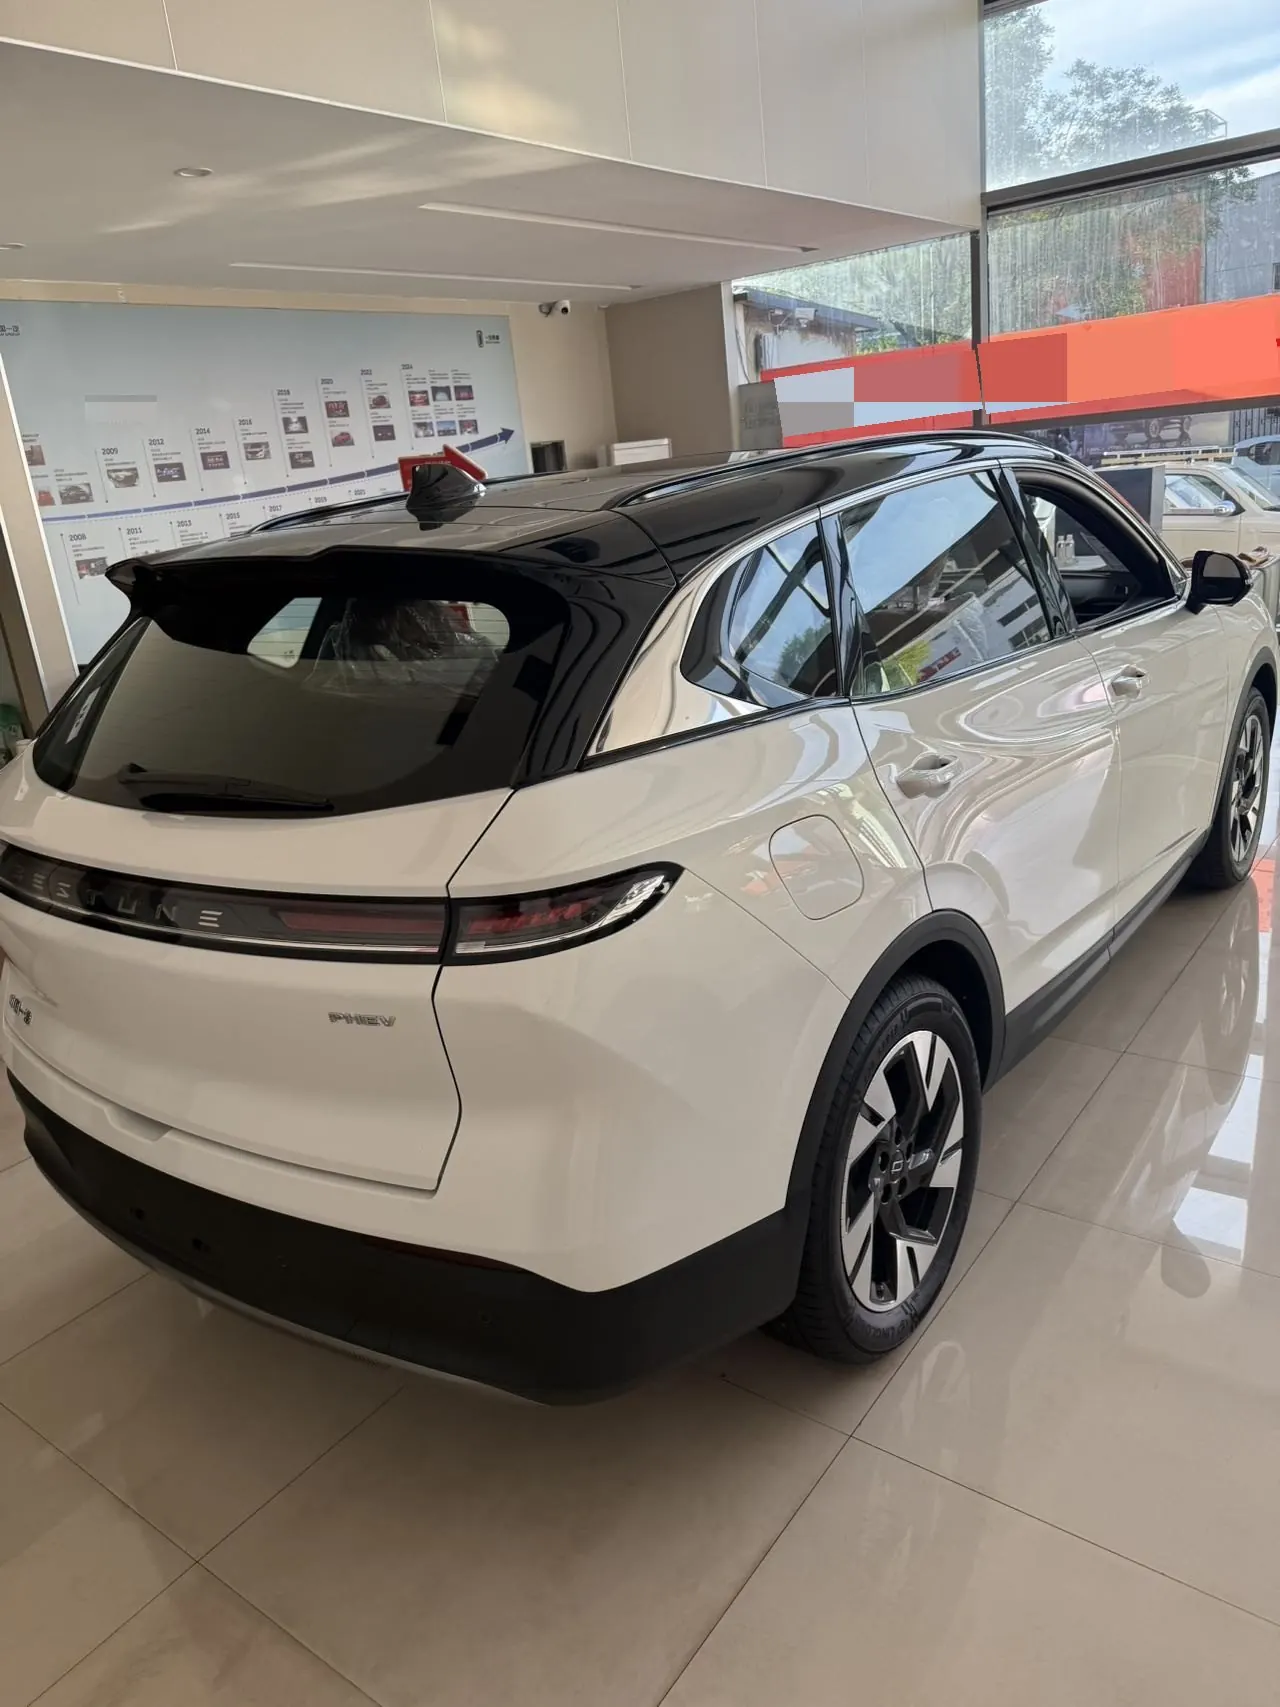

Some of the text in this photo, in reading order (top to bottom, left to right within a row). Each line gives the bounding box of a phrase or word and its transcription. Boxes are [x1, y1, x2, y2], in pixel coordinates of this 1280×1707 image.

[148, 438, 165, 446] 2012
[101, 448, 118, 456] 2009
[226, 512, 240, 520] 2015
[177, 520, 192, 528] 2013
[126, 527, 142, 535] 2011
[69, 533, 87, 542] 2008
[328, 1011, 397, 1027] PHEV
